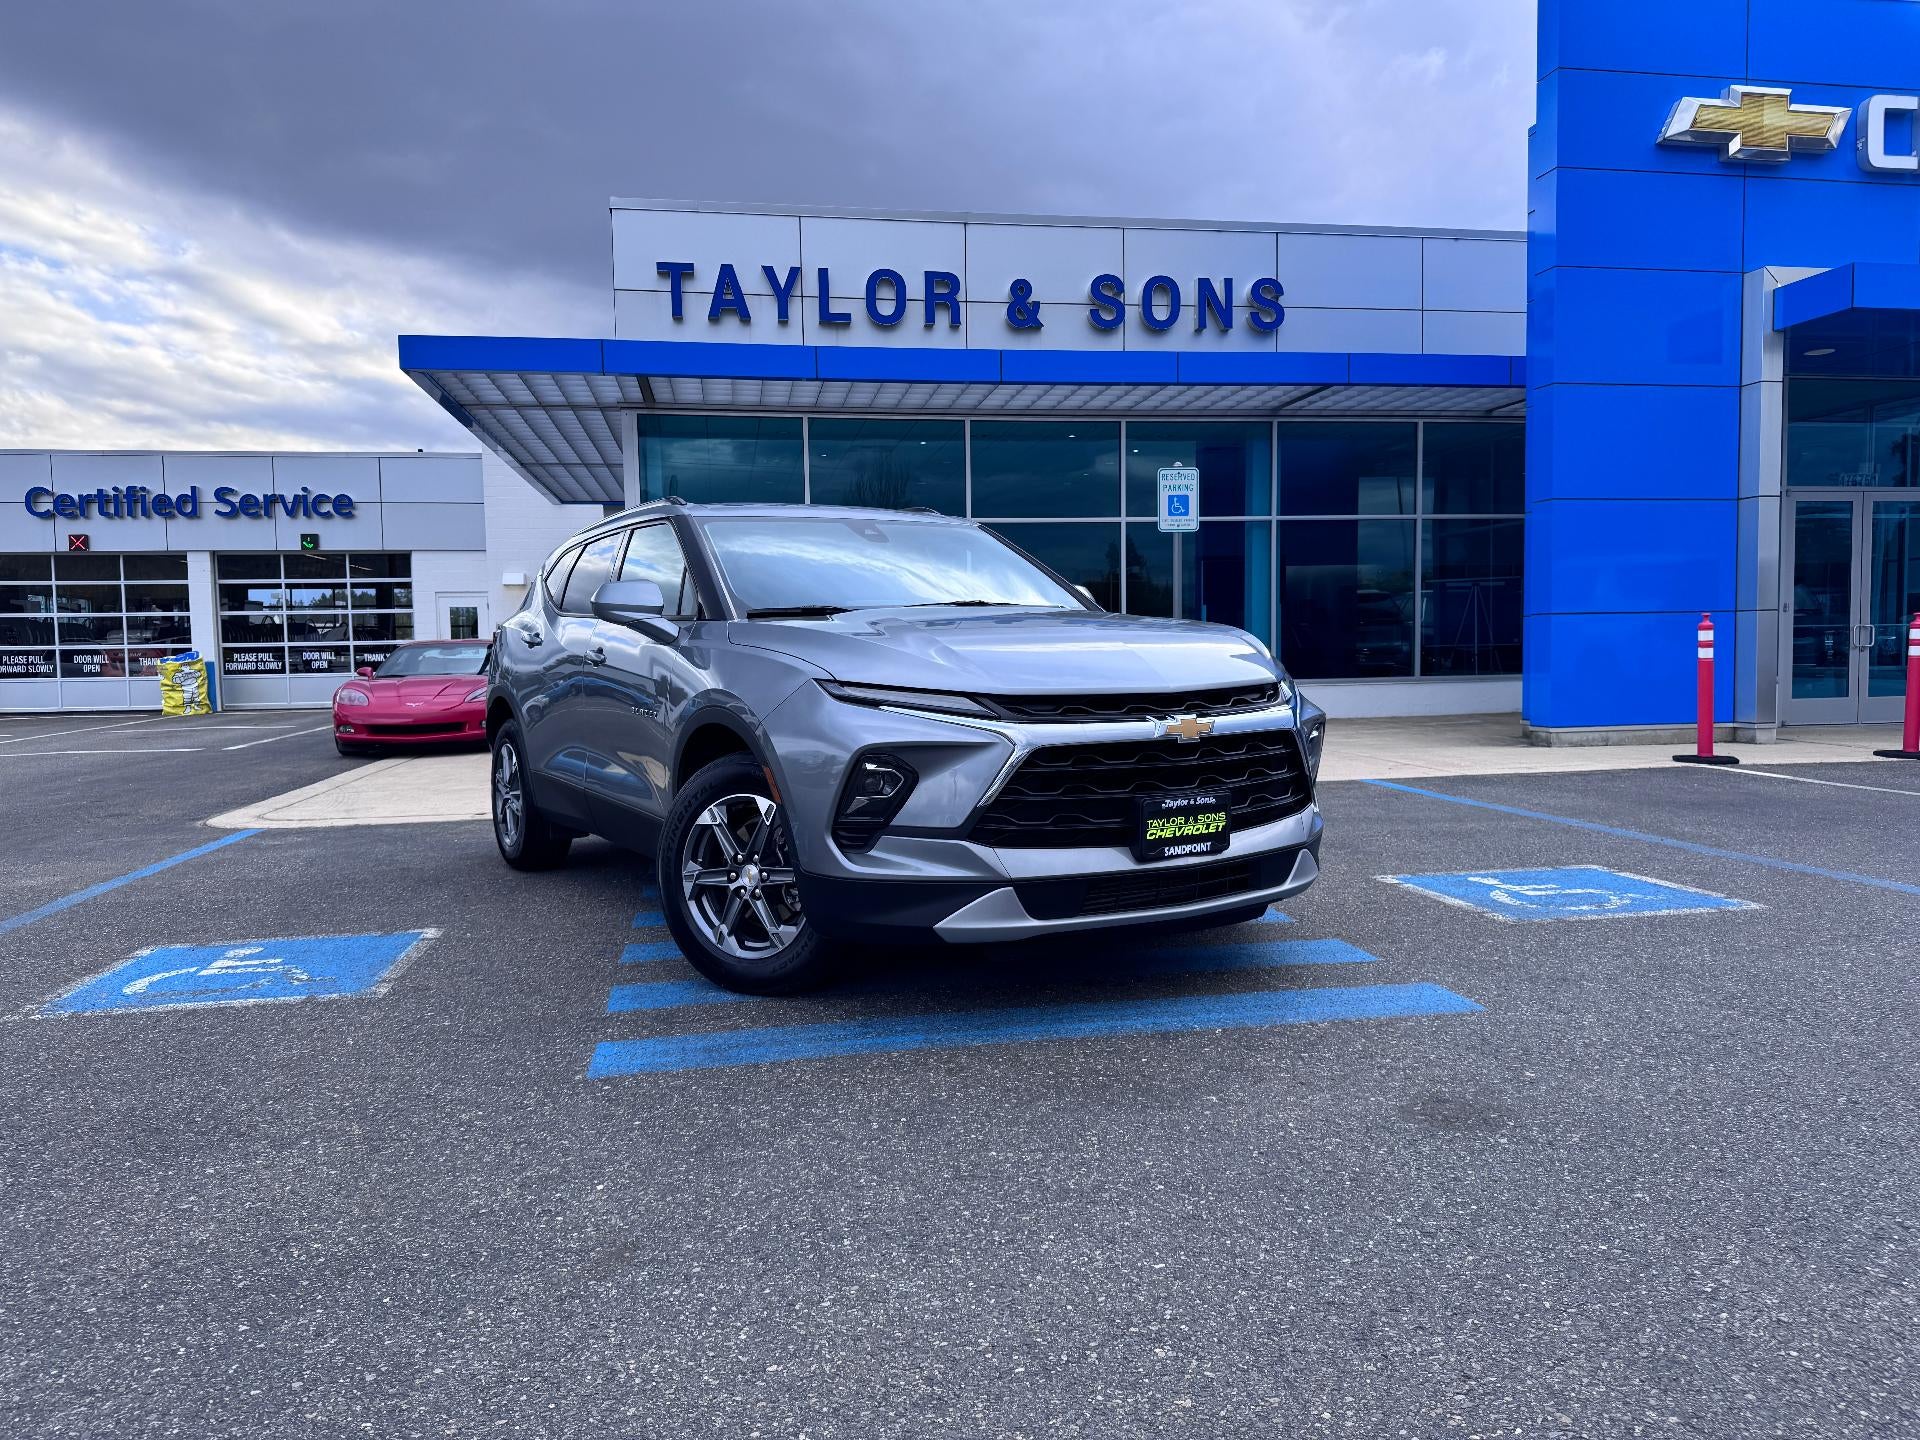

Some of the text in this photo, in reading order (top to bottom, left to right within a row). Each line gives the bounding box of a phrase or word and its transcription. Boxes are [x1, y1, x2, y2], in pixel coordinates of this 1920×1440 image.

[655, 261, 1285, 334] TAYLOR & SONS
[1161, 472, 1195, 481] RESERVED
[1162, 484, 1194, 492] PARKING
[24, 485, 355, 519] Certified Service
[3, 655, 46, 665] PLEASE PULL
[73, 654, 92, 664] DOOR
[93, 654, 110, 664] WILL
[233, 653, 275, 662] PLEASE PULL
[302, 651, 336, 660] DOOR WILL
[363, 653, 385, 662] THANK
[28, 664, 54, 673] SLOWLY
[83, 664, 101, 673] OPEN
[225, 661, 282, 671] FORWARD SLOWLY
[311, 660, 328, 669] OPEN
[1164, 799, 1188, 809] Taylor
[1196, 796, 1214, 805] Sons
[1147, 812, 1226, 828] TAYLOR & SONS
[1146, 821, 1226, 840] CHEVROLET
[1164, 841, 1212, 857] SANDPOINT
